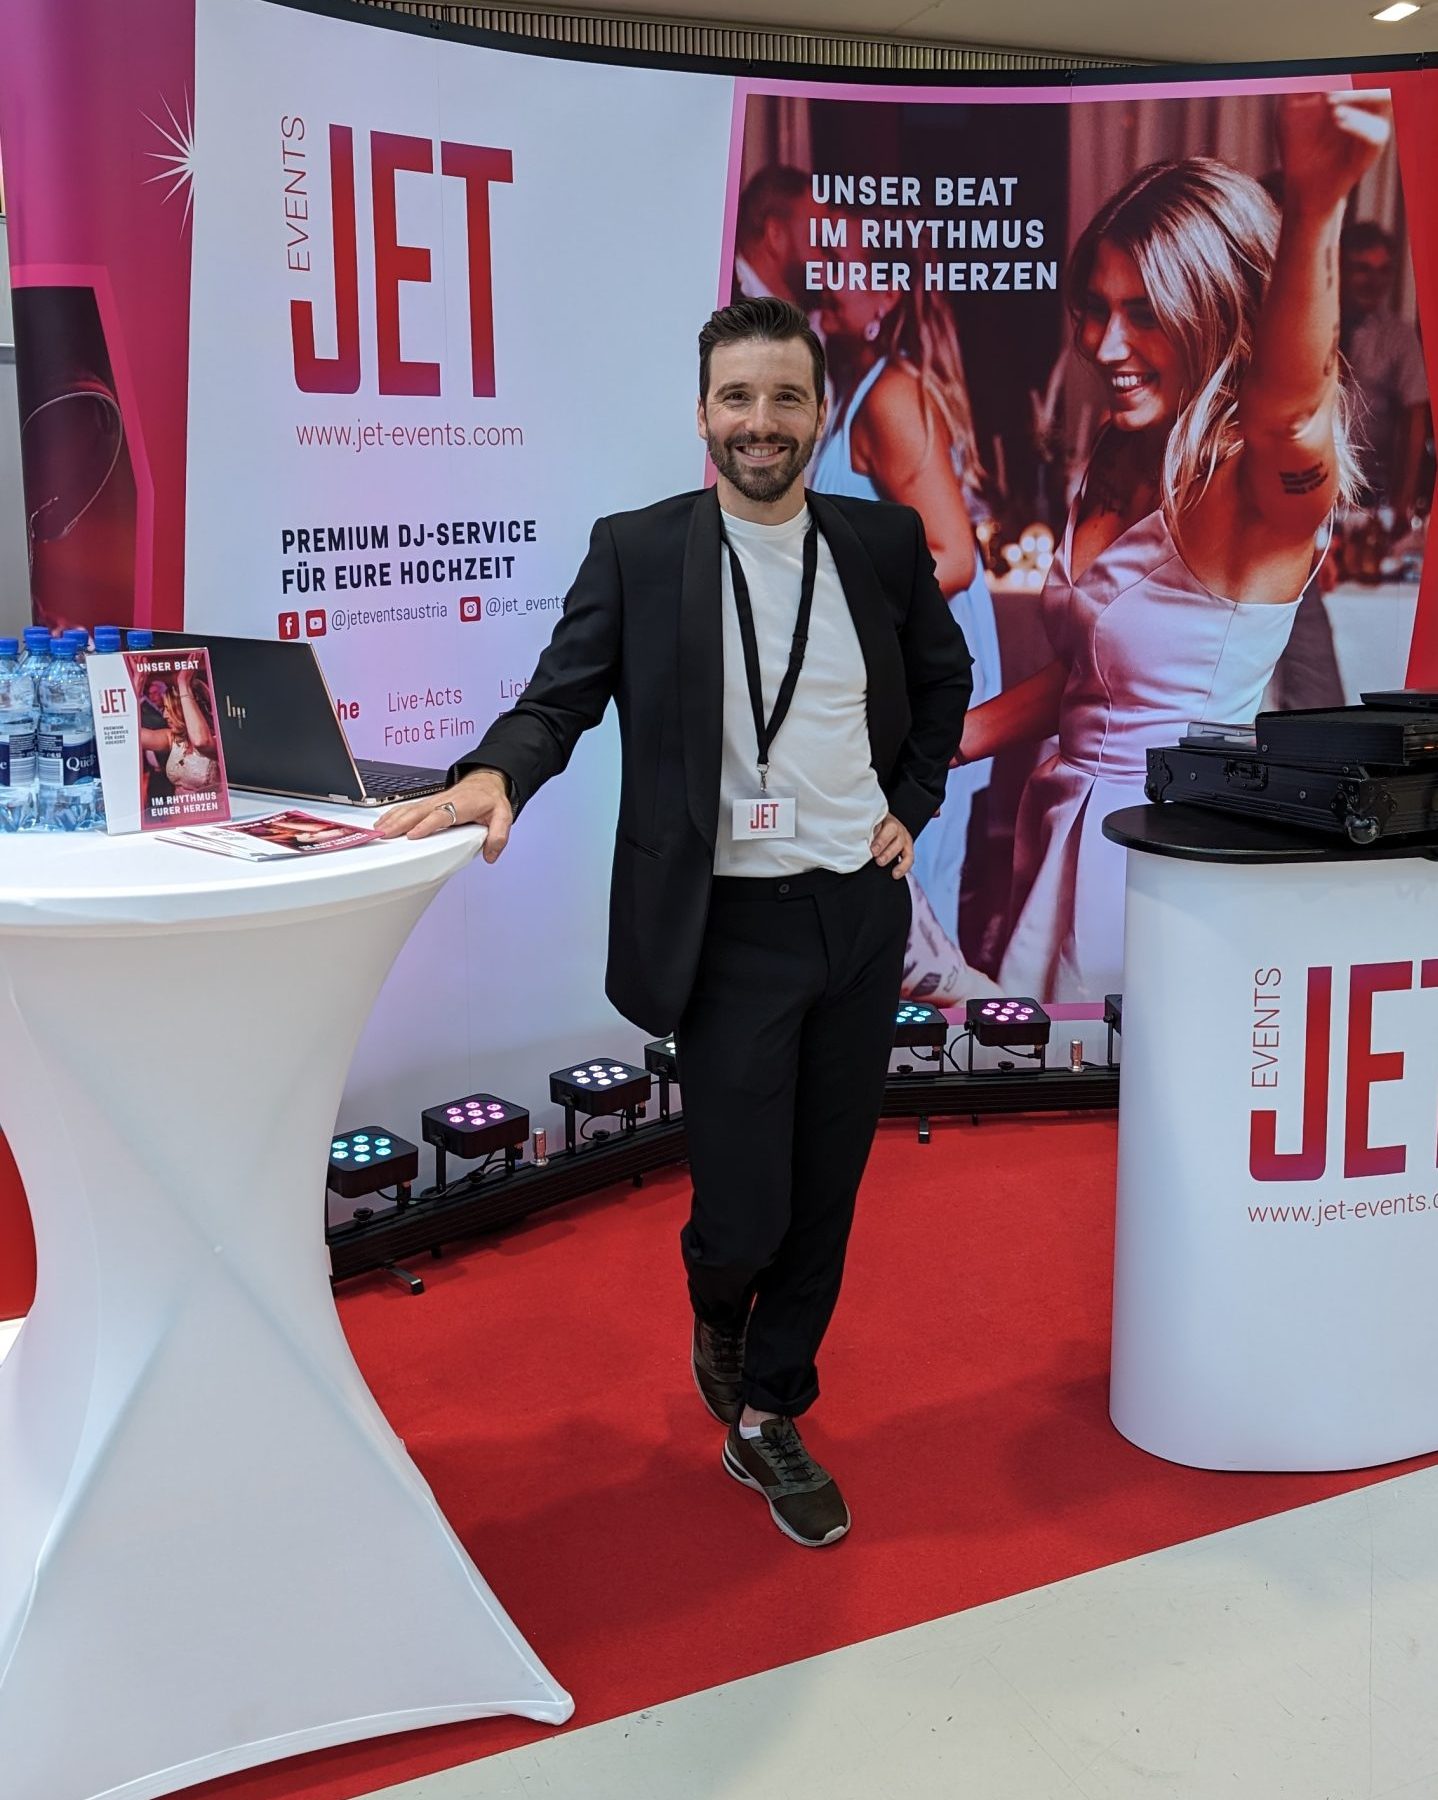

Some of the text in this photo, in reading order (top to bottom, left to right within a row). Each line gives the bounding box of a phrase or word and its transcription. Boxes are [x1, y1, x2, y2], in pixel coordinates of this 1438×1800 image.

[281, 115, 311, 272] EVENTS
[812, 174, 1018, 206] UNSER BEAT
[809, 218, 1044, 248] IM RHYTHMUS
[290, 123, 513, 398] JET
[805, 261, 1057, 291] EURER HERZEN
[296, 419, 524, 453] www.jet-events.com
[281, 520, 537, 555] PREMIUM DJ-SERVICE
[281, 556, 515, 595] FÜR EURE HOCHZEIT
[331, 602, 448, 631] @jeteventsaustria
[136, 660, 199, 673] UNSER BEAT
[101, 688, 126, 714] JET
[388, 686, 463, 713] Live-Acts
[384, 717, 475, 747] Foto & Film
[151, 791, 217, 806] IM RHYTHMUS
[151, 802, 219, 817] EURER HERZEN
[750, 803, 779, 829] JET
[1251, 967, 1282, 1088] EVENTS
